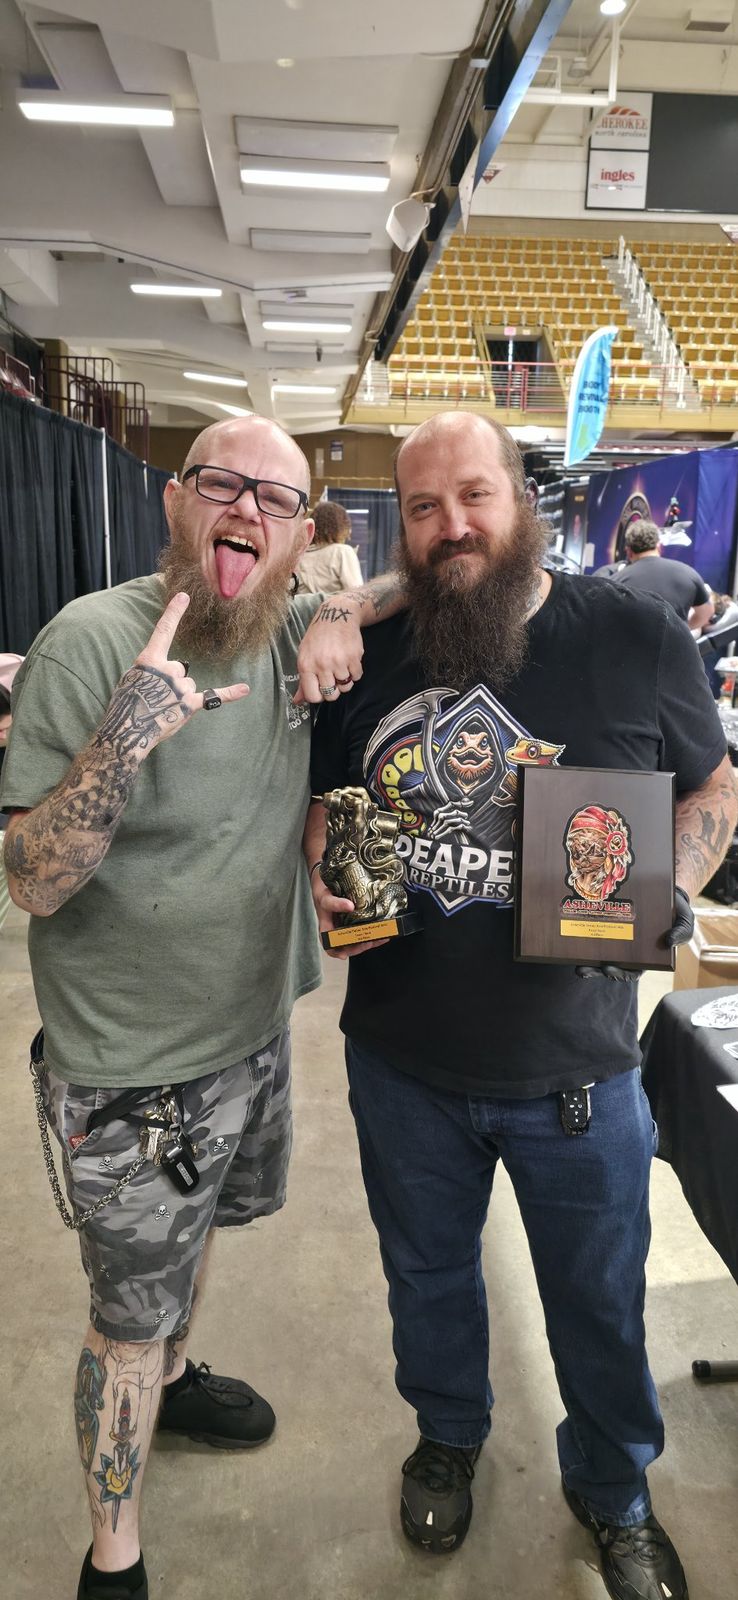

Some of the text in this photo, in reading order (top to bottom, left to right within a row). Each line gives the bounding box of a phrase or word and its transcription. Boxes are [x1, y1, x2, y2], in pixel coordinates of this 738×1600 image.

[600, 168, 635, 182] ingles
[395, 834, 513, 884] EAPE
[410, 867, 510, 899] REPTILES
[562, 899, 632, 913] ASHEVILLE
